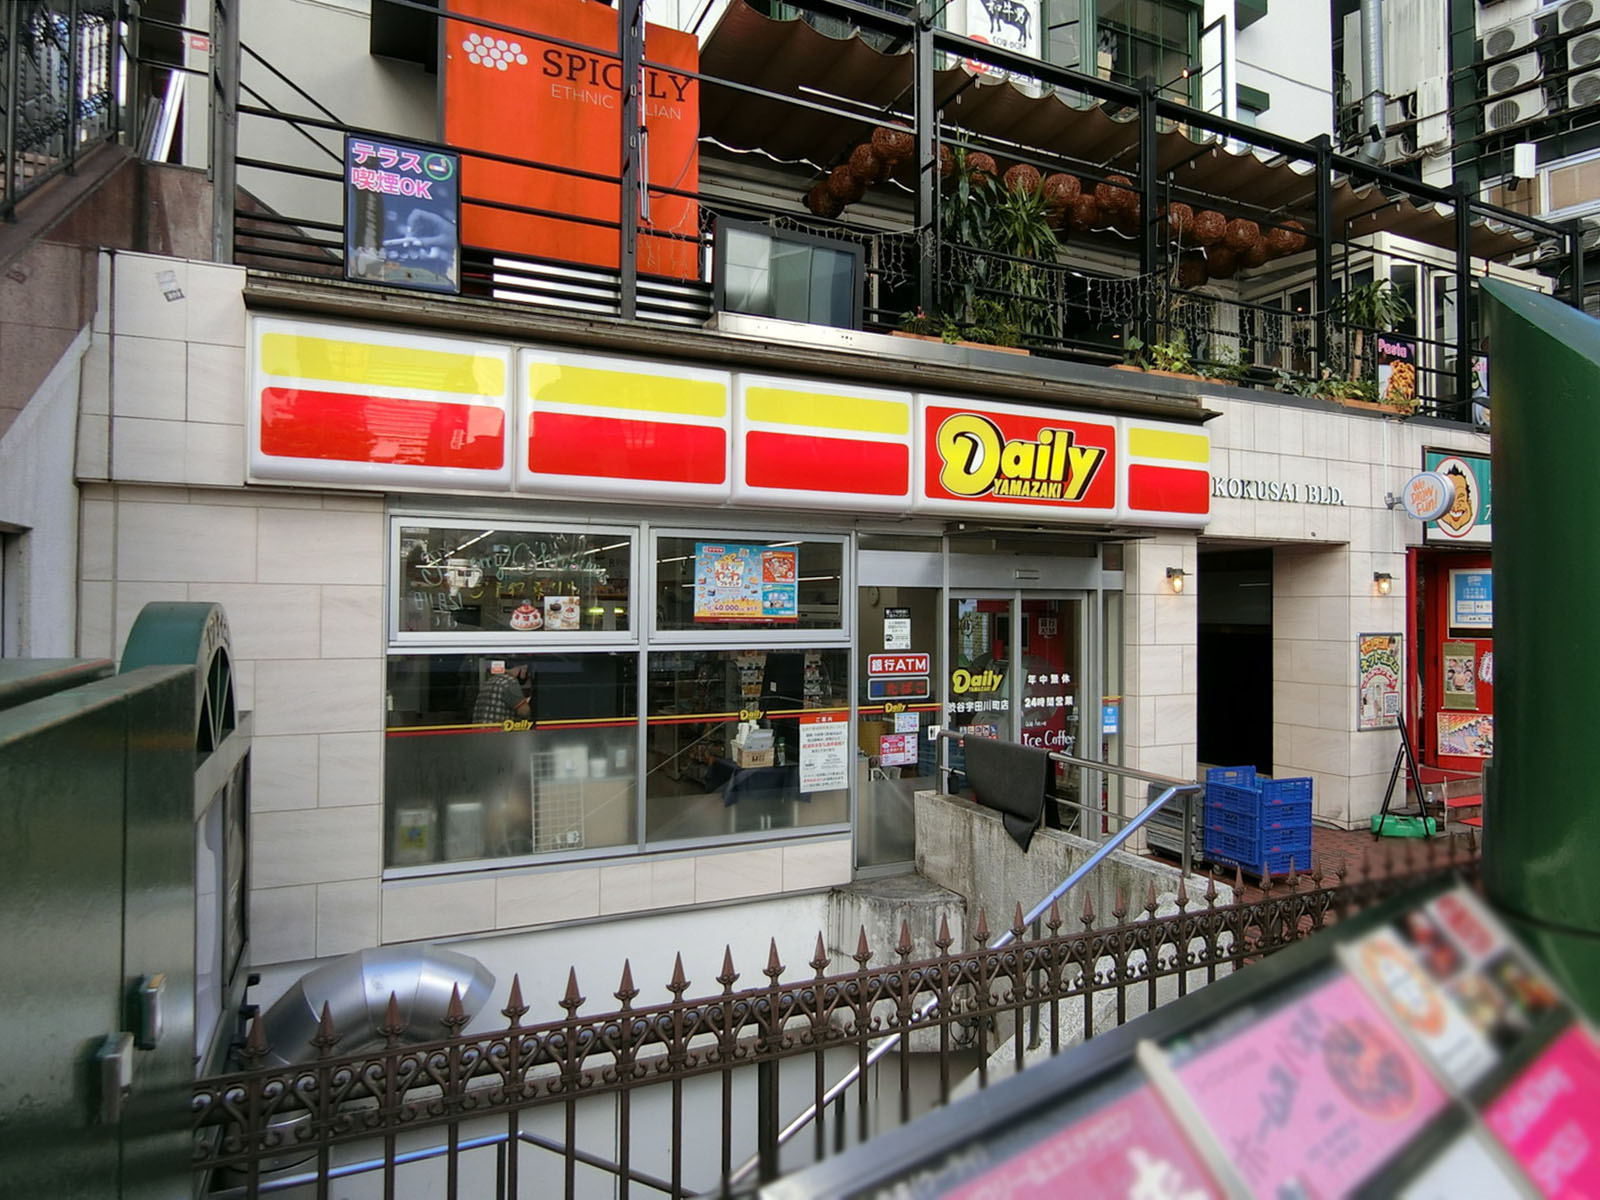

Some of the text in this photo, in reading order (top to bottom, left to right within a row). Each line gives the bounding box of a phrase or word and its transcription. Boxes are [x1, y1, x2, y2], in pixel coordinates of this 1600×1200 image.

[543, 49, 694, 102] SPICLY
[551, 83, 614, 109] ETHNIC
[352, 142, 422, 174] テラス
[351, 167, 433, 200] 喫煙OK
[1378, 338, 1407, 358] Pasta
[937, 413, 1106, 500] Daily
[993, 478, 1063, 498] YAMAZAKI
[1212, 477, 1347, 506] KOKUSAI BLD.
[871, 658, 926, 672] 銀行ATM
[952, 669, 1003, 693] Daily
[1027, 673, 1071, 685] 年中無休
[884, 702, 907, 713] Daily
[1024, 695, 1073, 708] 24時間営業
[739, 709, 765, 721] Daily
[502, 719, 534, 732] Daily
